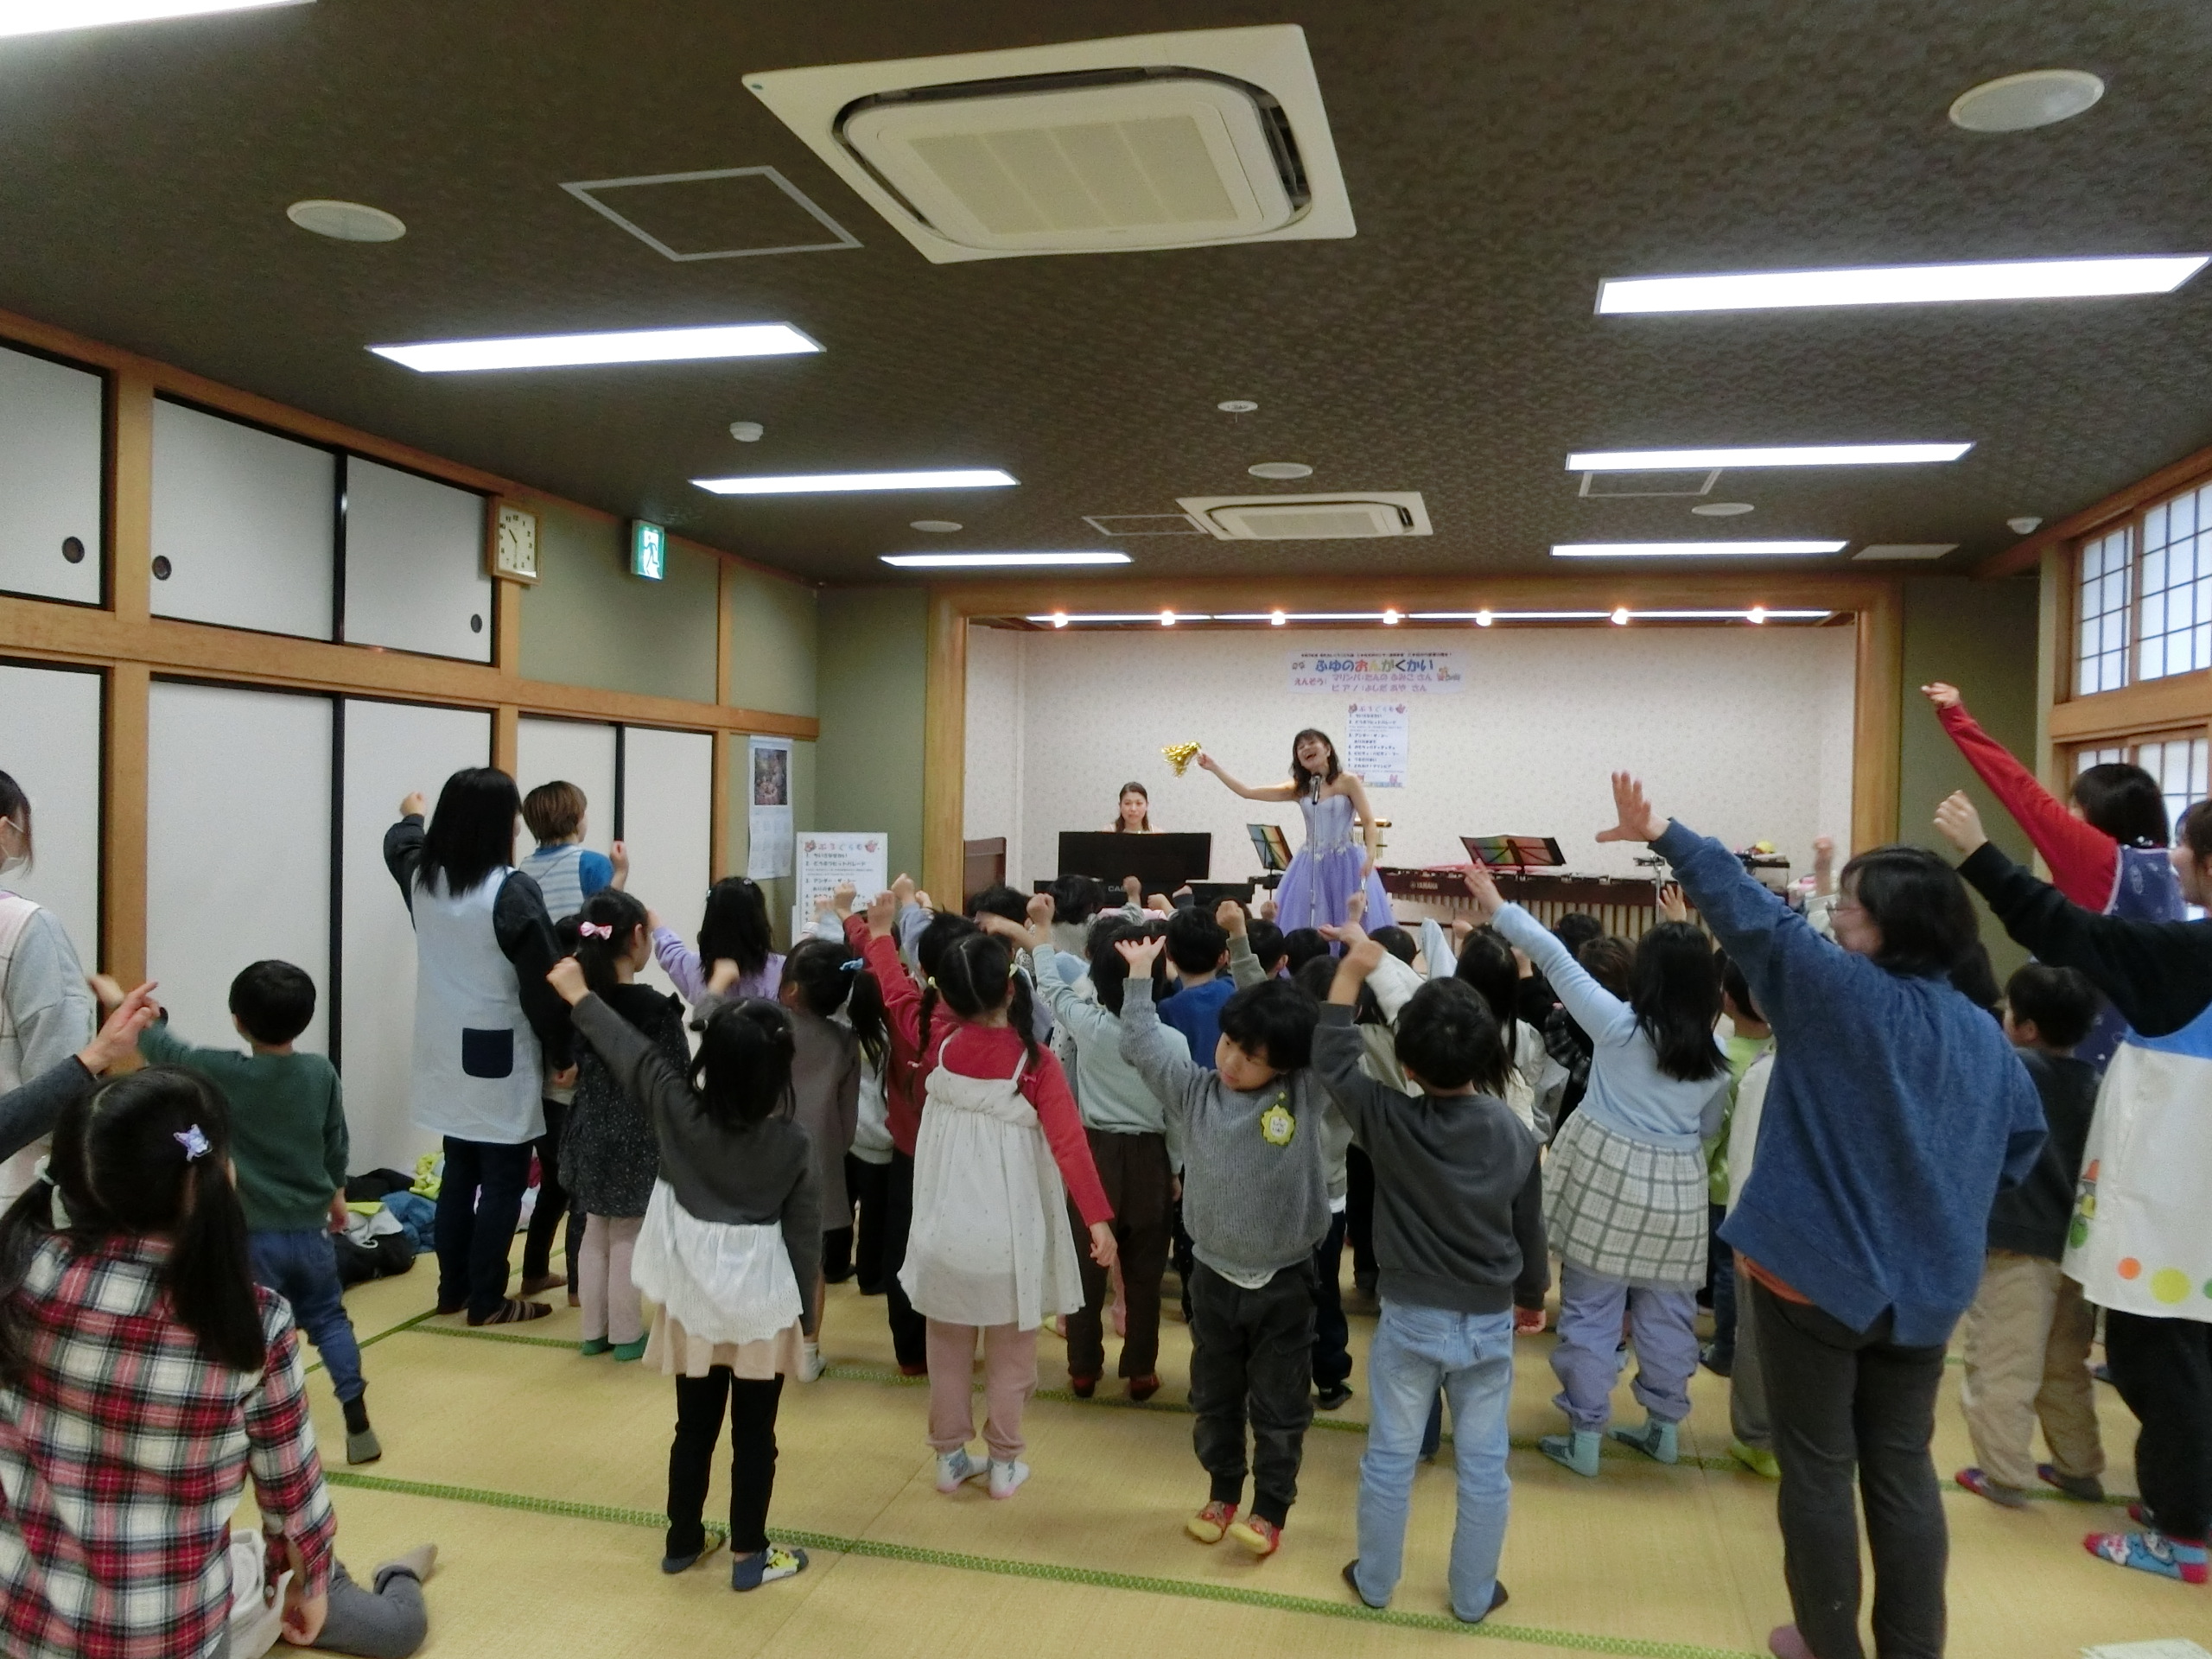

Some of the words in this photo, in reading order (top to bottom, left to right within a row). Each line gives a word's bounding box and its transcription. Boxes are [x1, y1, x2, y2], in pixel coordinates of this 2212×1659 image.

[1315, 659, 1433, 672] ふゆのおんがくかい
